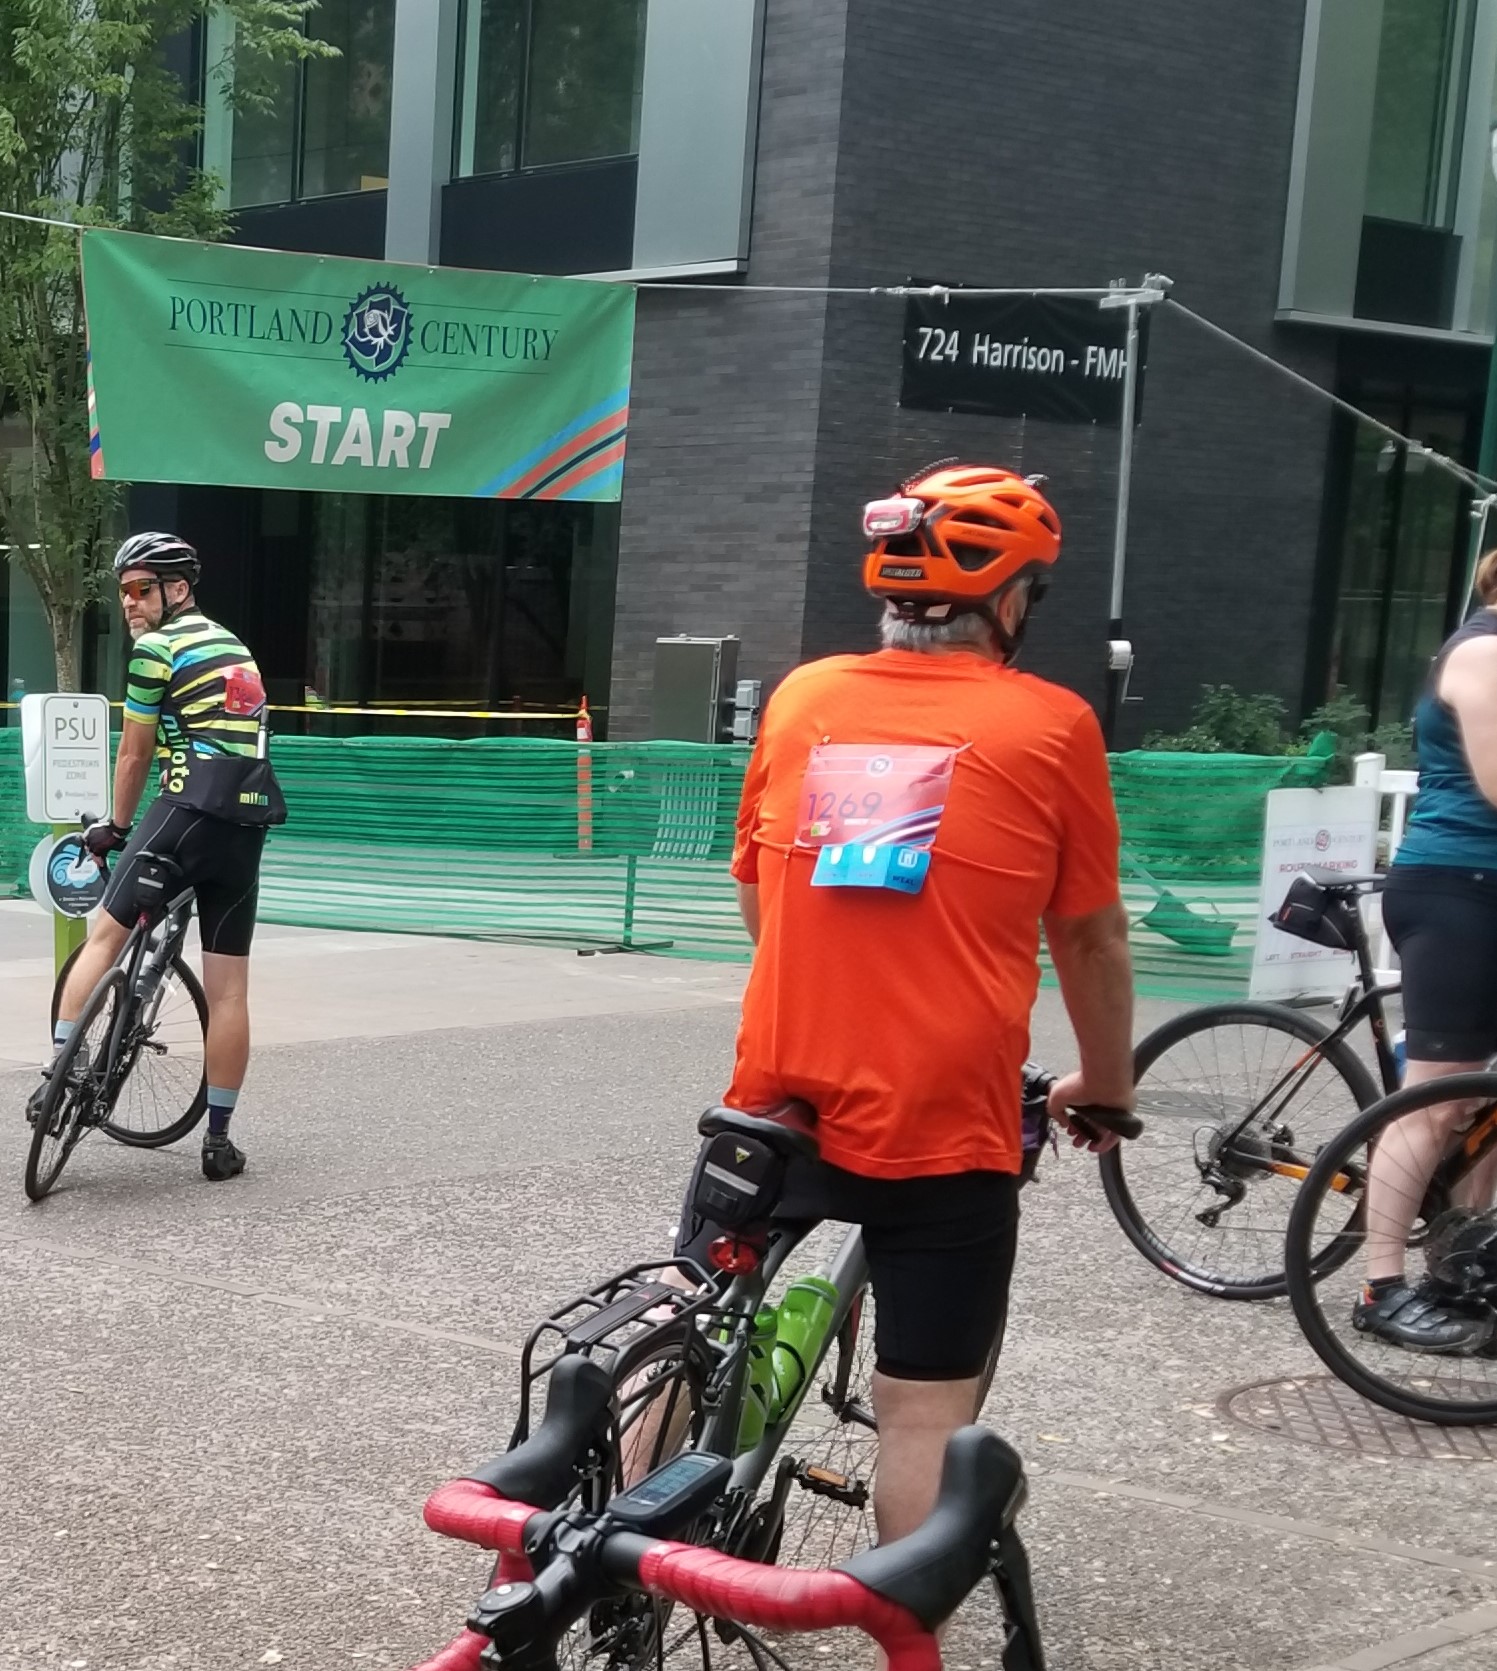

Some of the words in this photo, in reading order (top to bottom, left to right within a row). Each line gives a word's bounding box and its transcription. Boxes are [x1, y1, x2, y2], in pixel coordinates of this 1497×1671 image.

[168, 296, 333, 346] PORTLAND
[420, 319, 559, 362] CENTURY
[917, 327, 959, 362] 724
[972, 333, 1064, 373] Harrison
[264, 402, 452, 469] START
[55, 717, 96, 741] PSU
[808, 792, 883, 820] 1269
